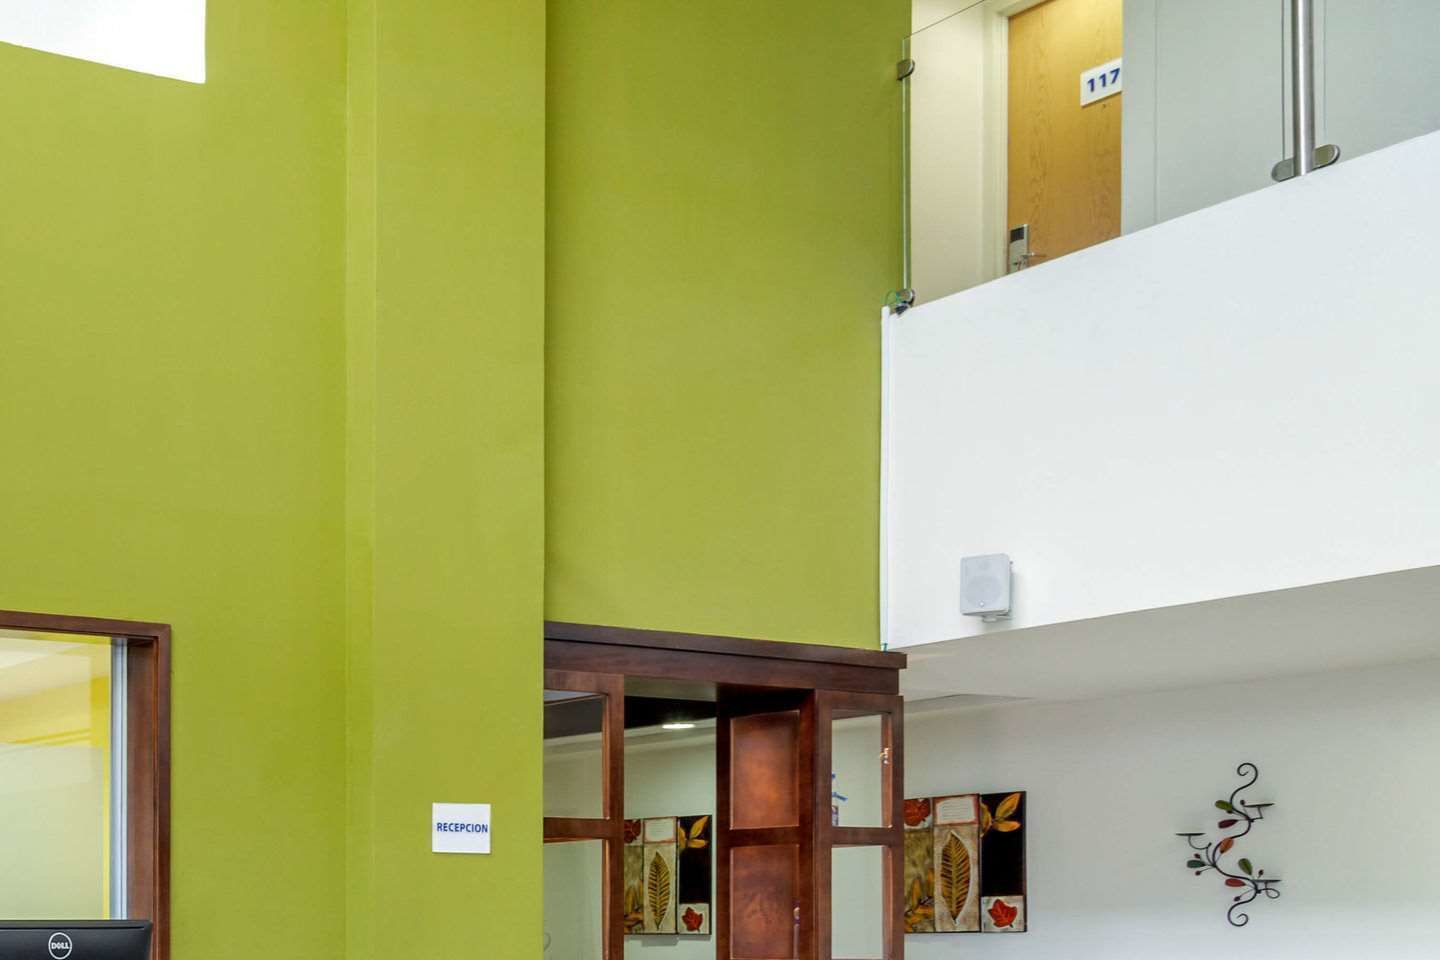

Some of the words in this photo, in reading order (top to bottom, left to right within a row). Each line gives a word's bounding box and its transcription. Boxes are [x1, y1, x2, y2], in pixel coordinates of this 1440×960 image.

[1087, 67, 1121, 93] 117
[436, 822, 489, 833] RECEPCION
[51, 941, 70, 950] DELL
